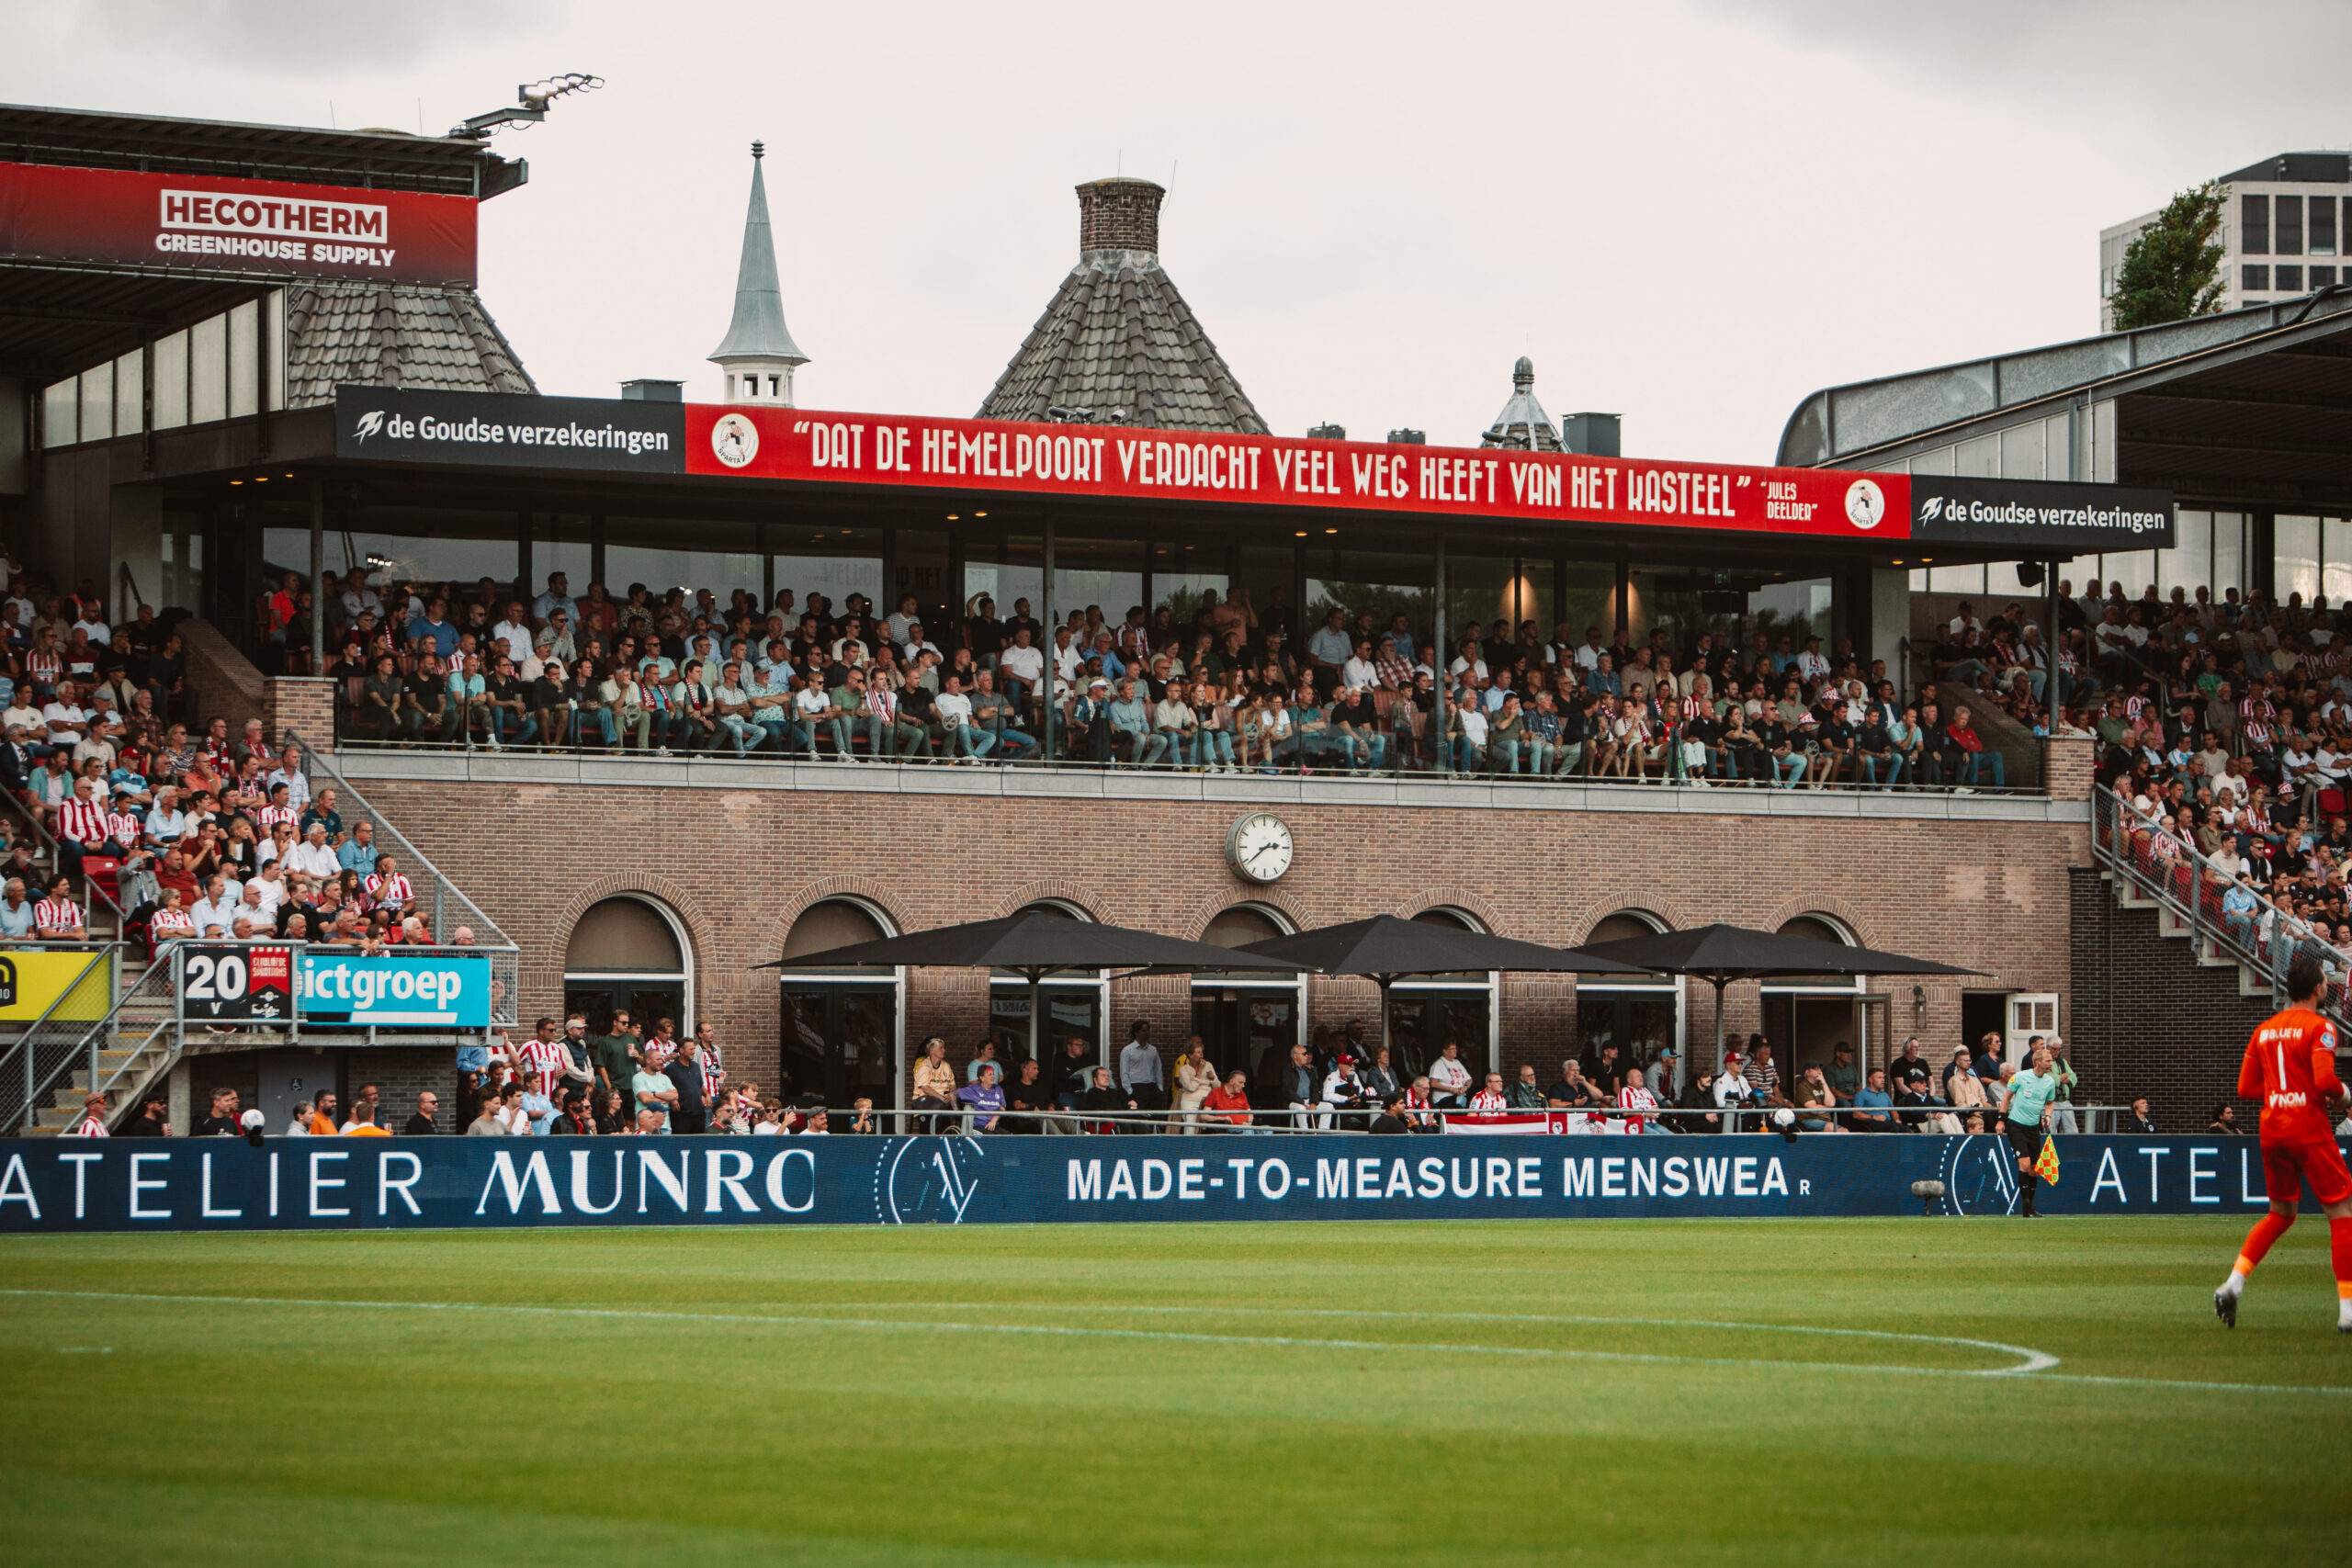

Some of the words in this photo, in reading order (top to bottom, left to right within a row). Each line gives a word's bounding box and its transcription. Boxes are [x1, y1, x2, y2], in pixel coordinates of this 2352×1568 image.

[165, 194, 383, 237] HECOTHERM
[155, 232, 308, 262] GREENHOUSE
[312, 243, 396, 267] SUPPLY
[387, 413, 415, 439] de
[420, 415, 504, 445] Goudse
[509, 422, 670, 456] verzekeringen
[876, 426, 911, 472] DE
[922, 428, 1104, 482] HEMELPOORT
[1117, 439, 1261, 491] VERDACHT
[1272, 448, 1340, 495] VEEL
[1351, 453, 1409, 498] WEG
[1420, 457, 1498, 503] HEEFT
[1510, 462, 1562, 507] VAN
[1572, 466, 1617, 510] HET
[1945, 499, 1967, 523] de
[1970, 501, 2036, 525] Goudse
[2039, 506, 2165, 533] verzekeringen
[185, 954, 247, 999] 20
[306, 958, 462, 1010] ictgroep
[2277, 1041, 2287, 1092] 1
[0, 1151, 423, 1219] ATELIER
[1067, 1156, 1544, 1200] MADE-TO-MEASURE
